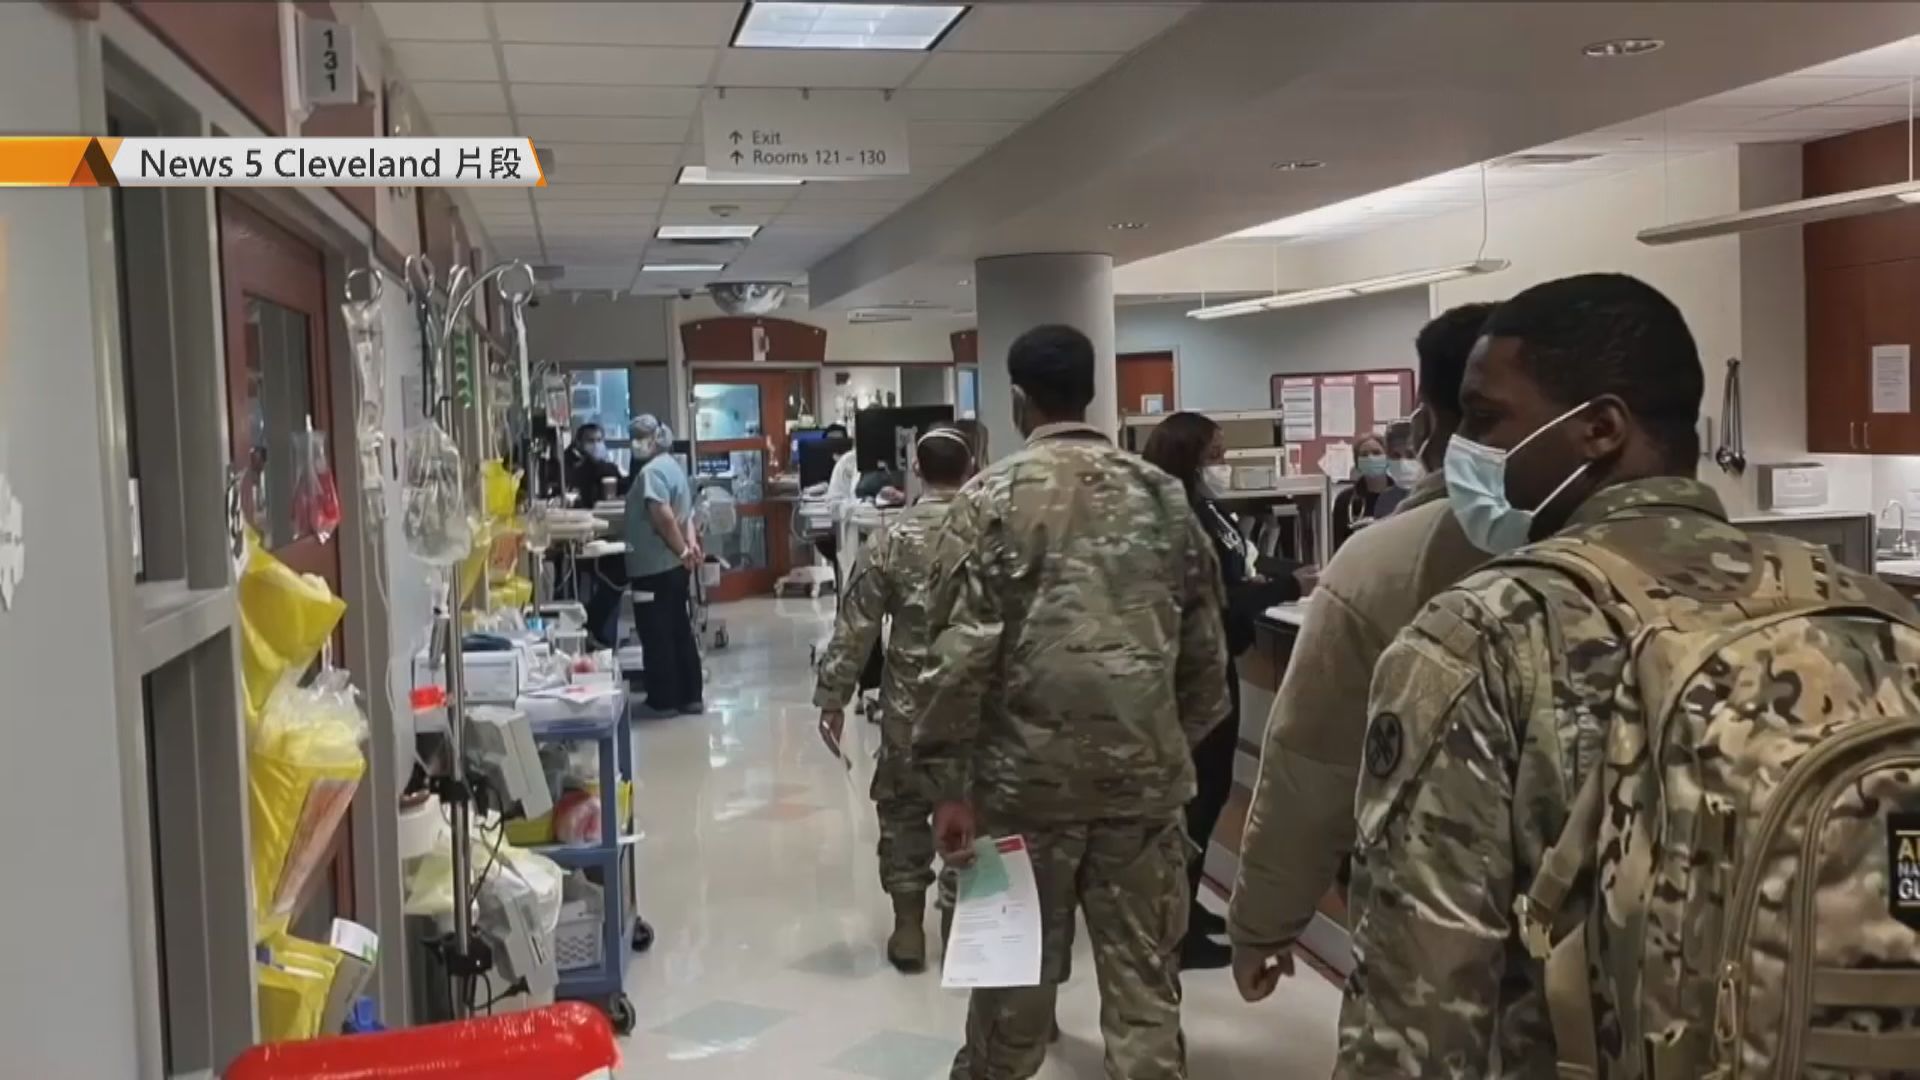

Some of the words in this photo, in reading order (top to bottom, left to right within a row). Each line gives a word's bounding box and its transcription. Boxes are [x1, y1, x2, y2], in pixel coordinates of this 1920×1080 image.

[323, 29, 338, 93] 131
[751, 130, 782, 145] Exit
[752, 150, 809, 165] Rooms
[1898, 837, 1920, 862] A
